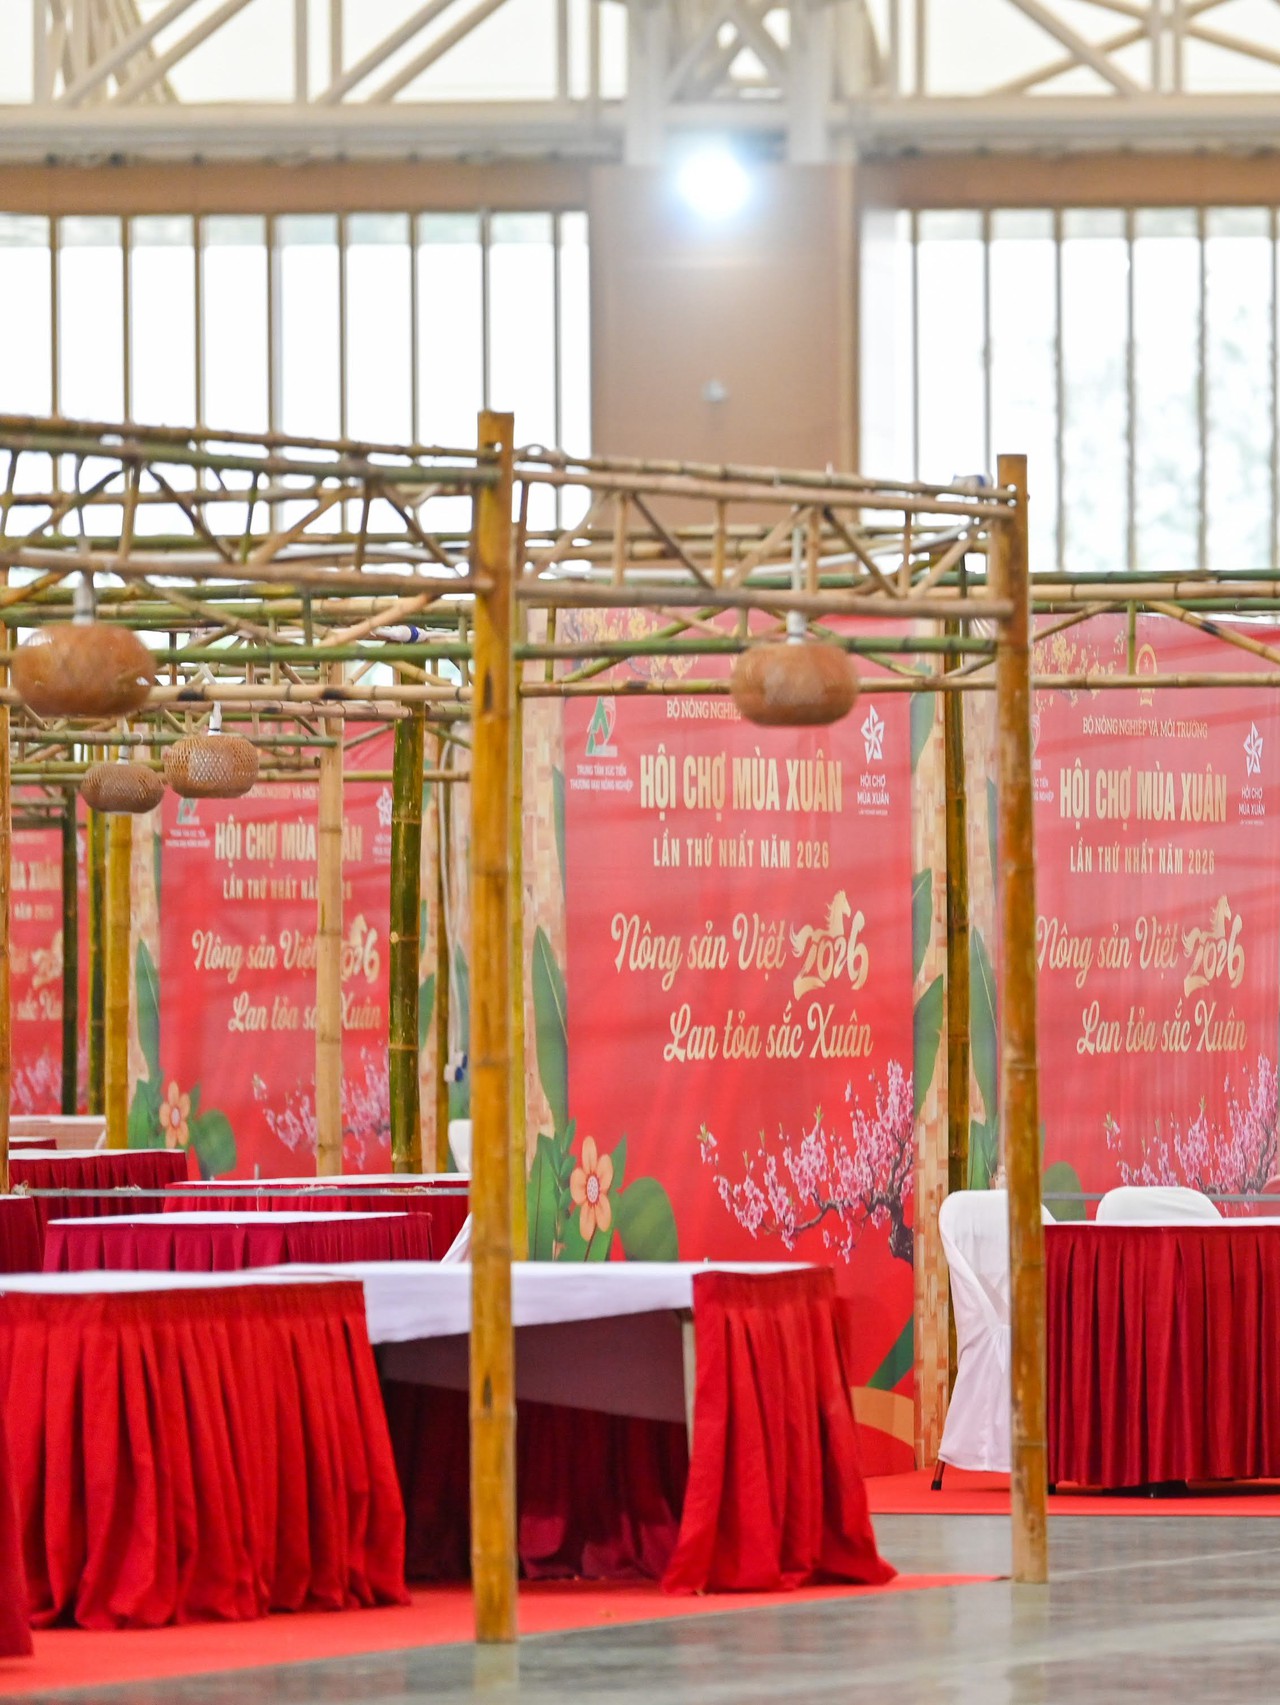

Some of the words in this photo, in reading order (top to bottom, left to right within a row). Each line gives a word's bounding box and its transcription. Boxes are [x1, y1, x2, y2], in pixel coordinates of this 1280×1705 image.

[667, 697, 680, 721] BỘ
[681, 697, 710, 719] NÔNG
[1083, 717, 1093, 737] BỘ
[1095, 718, 1118, 735] NÔNG
[1149, 719, 1160, 737] VÀ
[1160, 719, 1174, 737] MÔI
[640, 743, 676, 821] HỘI
[683, 752, 726, 822] CHỢ
[732, 746, 780, 811] MÙA
[786, 748, 842, 812] XUÂN
[1060, 757, 1090, 830] HỘI
[1095, 766, 1131, 831] CHỢ
[1136, 761, 1176, 821] MÙA
[1180, 763, 1227, 822] XUÂN
[215, 813, 242, 868] HỘI
[245, 820, 278, 868] CHỢ
[281, 817, 317, 861] MÙA
[653, 828, 680, 867] LẦN
[687, 832, 713, 867] THỨ
[719, 829, 754, 868] NHẤT
[761, 834, 790, 868] NĂM
[797, 841, 829, 869] 2026
[1070, 837, 1092, 873] LẦN
[1098, 841, 1120, 873] THỨ
[1125, 838, 1154, 874] NHẤT
[1159, 842, 1183, 874] NĂM
[1188, 849, 1215, 875] 2026
[301, 876, 318, 900] NĂ
[192, 929, 243, 984] Nông
[247, 935, 277, 971] sản
[610, 913, 684, 992] Nông
[687, 920, 729, 971] sản
[732, 913, 786, 981] Việt
[789, 889, 869, 1001] 2026
[1036, 915, 1093, 989] Nông
[1098, 922, 1132, 969] sản
[1135, 915, 1179, 979] Việt
[1181, 895, 1245, 998] 2026
[228, 991, 267, 1032] Lan
[663, 1003, 719, 1063] Lan
[722, 1009, 762, 1060] tỏa
[765, 1000, 805, 1060] sắc
[806, 1002, 874, 1060] Xuân
[1076, 1000, 1122, 1055] Lan
[1126, 1006, 1158, 1053] tỏa
[1160, 997, 1191, 1053] sắc
[1194, 999, 1248, 1053] Xuân
